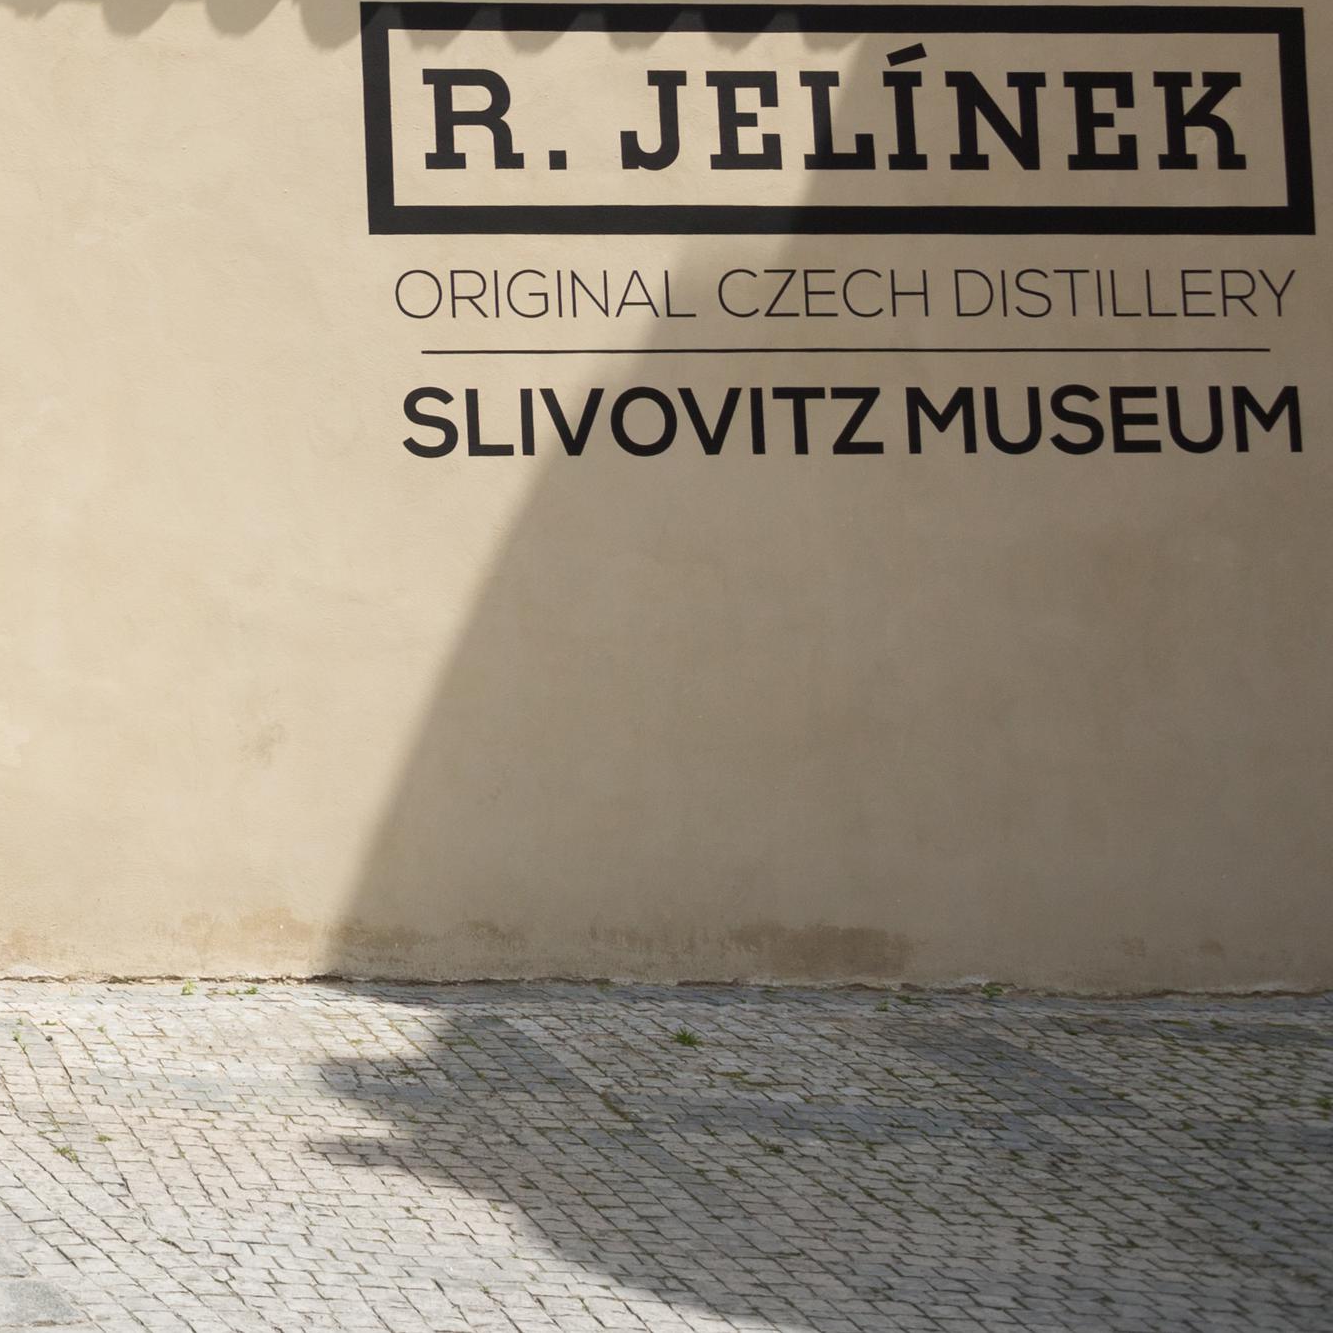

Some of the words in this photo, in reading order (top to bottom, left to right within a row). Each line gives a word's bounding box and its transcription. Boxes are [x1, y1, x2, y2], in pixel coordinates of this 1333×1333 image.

[423, 68, 569, 172] R.
[619, 41, 1247, 172] JELÍNEK
[394, 269, 698, 321] ORIGINAL
[717, 269, 931, 319] CZECH
[954, 269, 1297, 319] DISTILLERY
[402, 385, 886, 459] SLIVOVITZ
[906, 384, 1304, 456] MUSEUM
